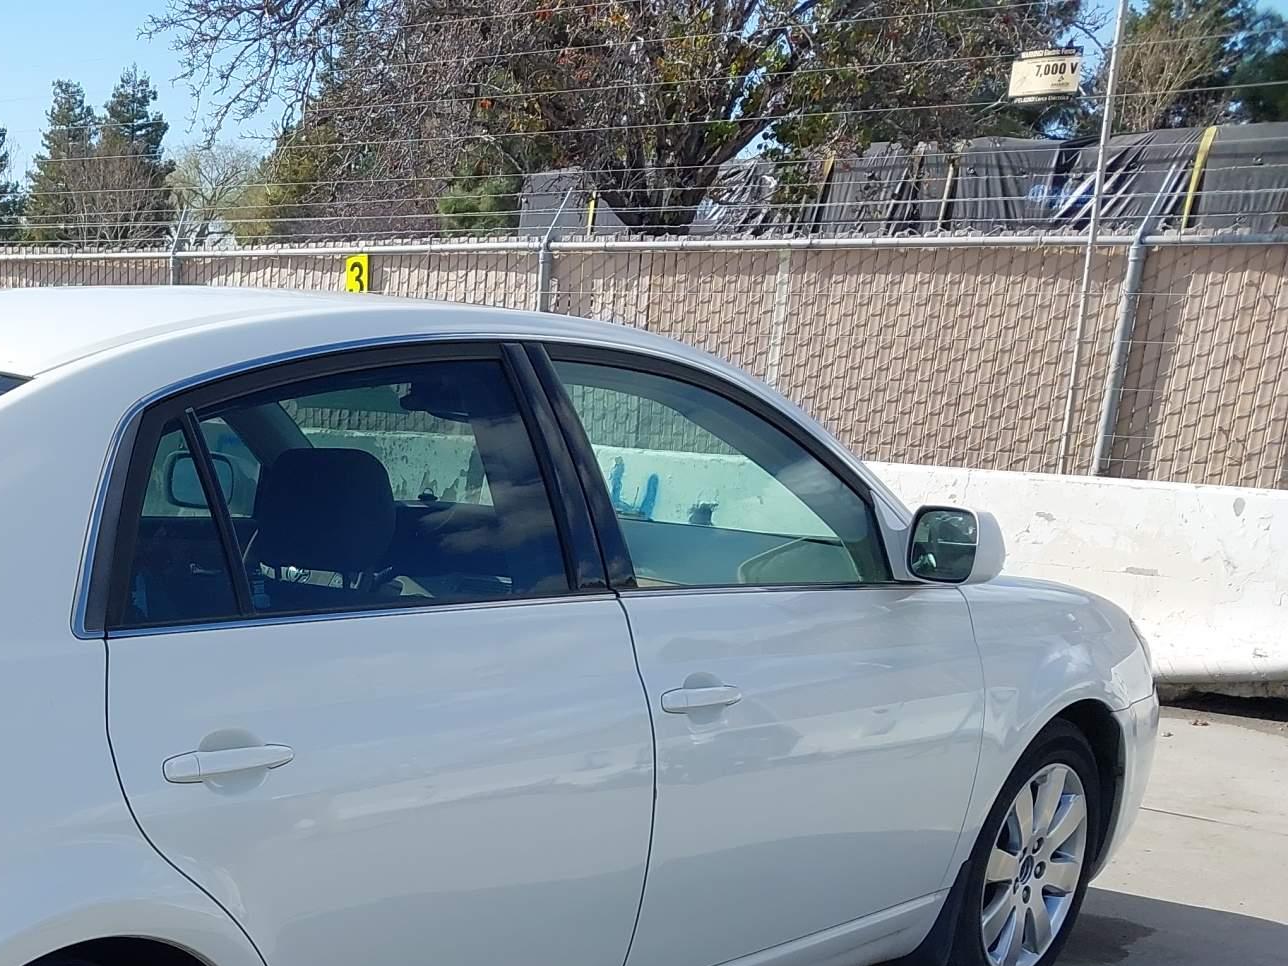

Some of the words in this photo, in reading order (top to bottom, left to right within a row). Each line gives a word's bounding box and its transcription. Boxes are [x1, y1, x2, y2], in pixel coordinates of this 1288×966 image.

[1035, 62, 1067, 78] 7,000
[1070, 61, 1079, 75] V
[349, 261, 364, 293] 3
